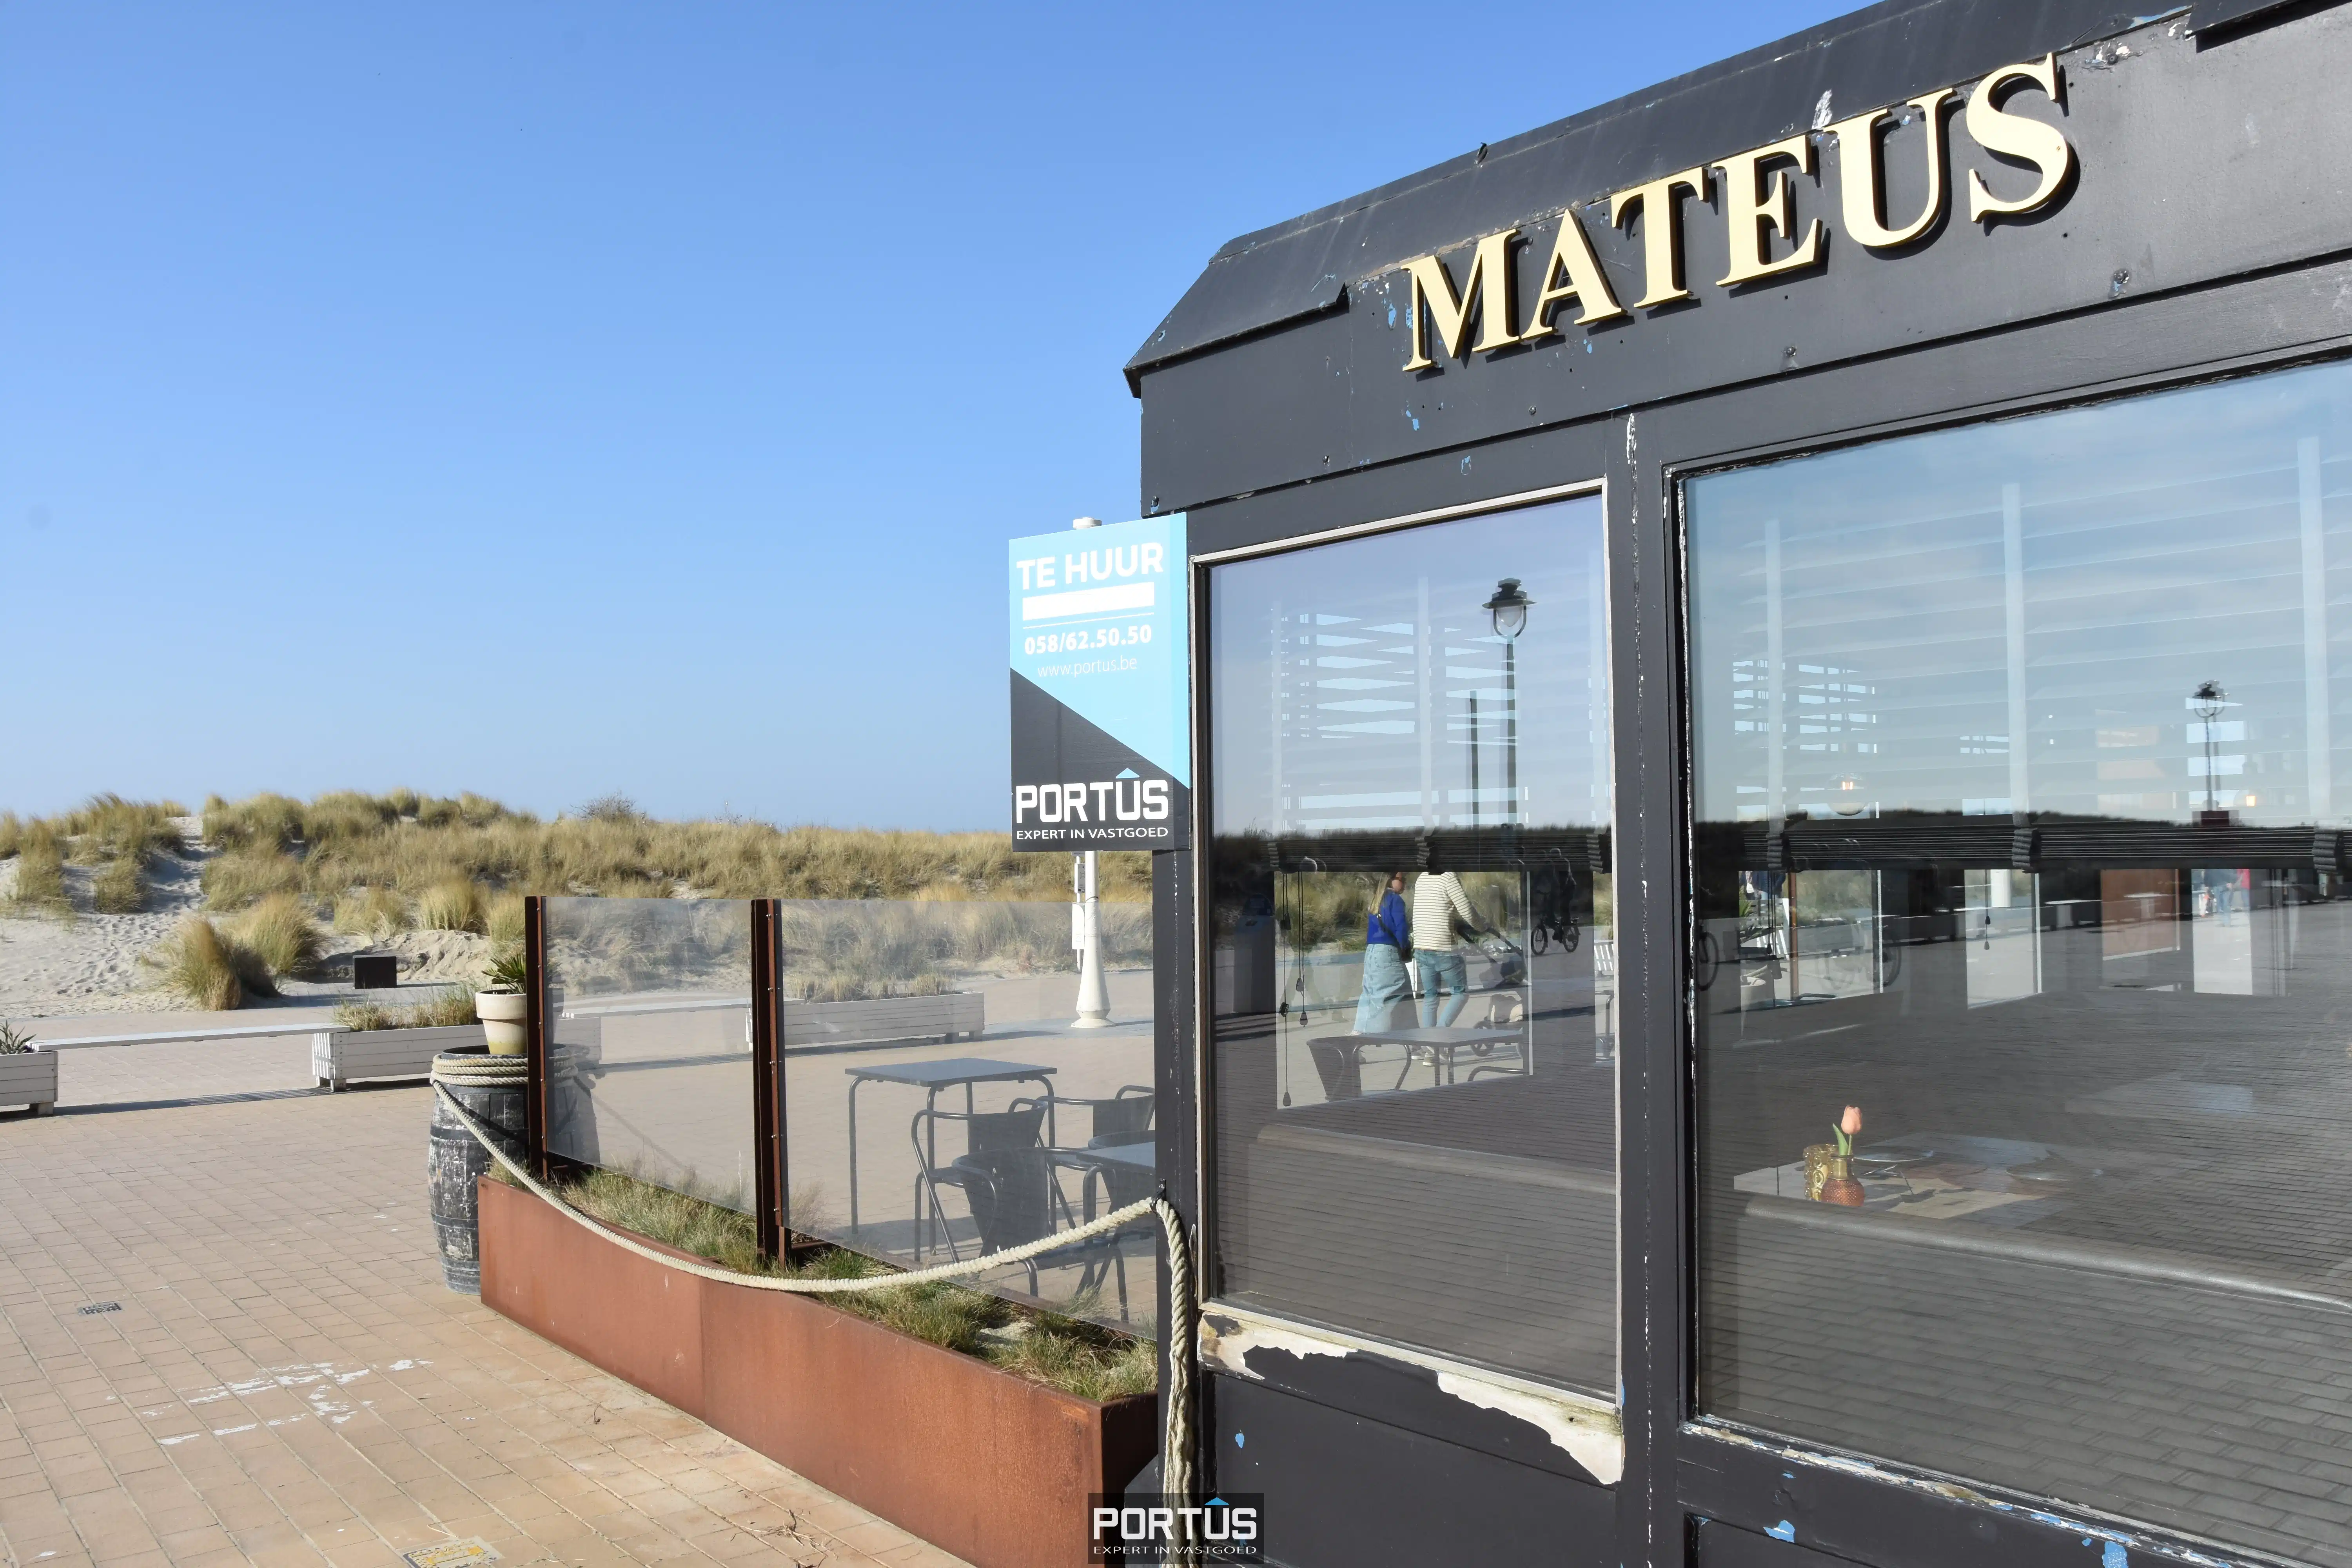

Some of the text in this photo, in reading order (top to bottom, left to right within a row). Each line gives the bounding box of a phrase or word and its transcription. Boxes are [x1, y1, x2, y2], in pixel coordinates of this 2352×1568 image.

[1401, 53, 2073, 372] MATEUS
[1016, 542, 1164, 590] TE HUUR
[1025, 624, 1152, 655] 058/62.50.50
[1037, 655, 1138, 677] www.portus.be
[1016, 779, 1169, 823] PORTUS
[1016, 827, 1168, 840] EXPERT IN VASTGOED
